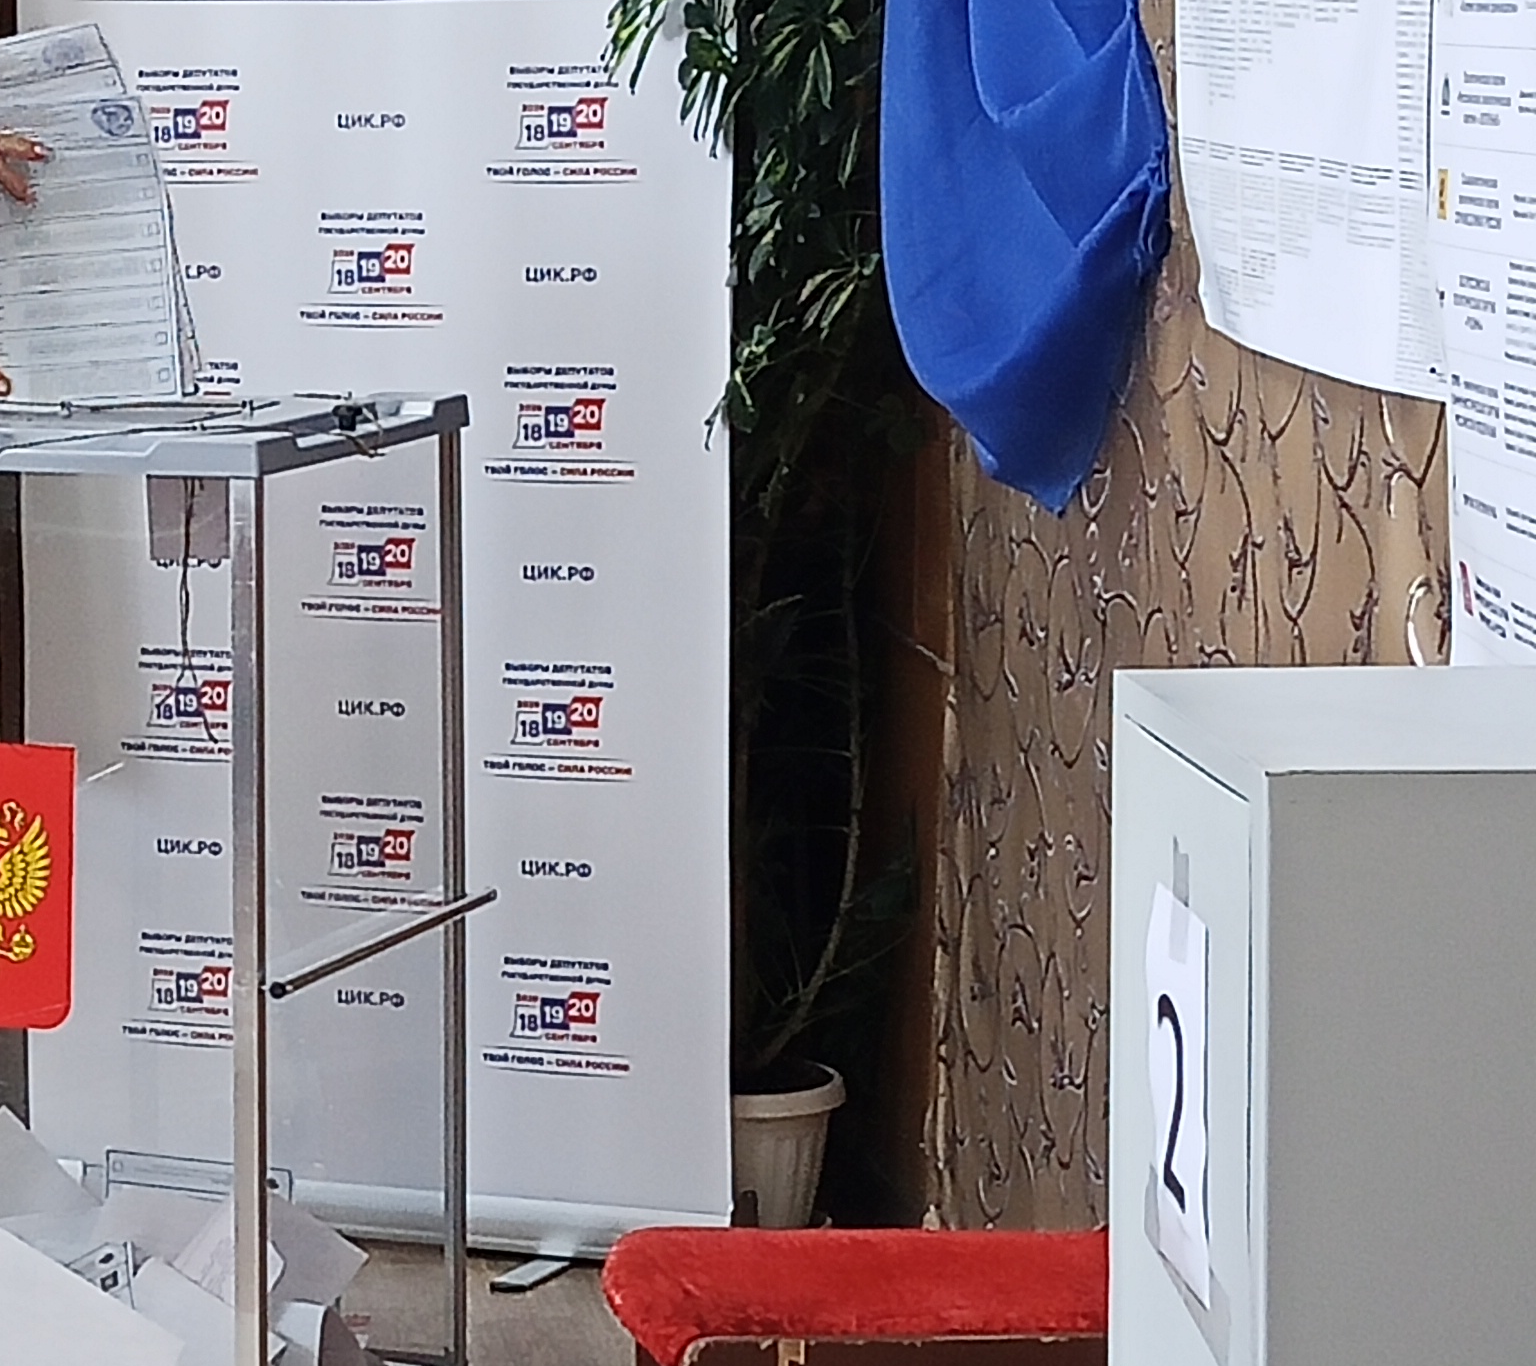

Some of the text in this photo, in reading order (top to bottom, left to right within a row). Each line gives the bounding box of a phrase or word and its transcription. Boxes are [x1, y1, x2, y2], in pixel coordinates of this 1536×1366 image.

[154, 106, 223, 142] 18 19 20
[338, 113, 405, 129] ЦИК.РФ
[525, 105, 601, 141] 18 19 20
[336, 250, 408, 286] 18 19 20
[526, 267, 597, 282] ЦИК.РФ
[523, 405, 599, 441] 18 19 20
[337, 544, 409, 578] 18 19 20
[523, 565, 594, 581] ЦИК.РФ
[178, 694, 197, 712] 19
[201, 687, 225, 704] 20
[338, 699, 405, 717] ЦИК.РФ
[520, 703, 596, 737] 18 19 20
[157, 838, 222, 856] ЦИК.РФ
[337, 836, 408, 869] 18 19 20
[521, 860, 592, 877] ЦИК.РФ
[156, 972, 225, 1004] 18 19 20
[337, 989, 405, 1007] ЦИК.РФ
[519, 999, 594, 1031] 18 19 20
[1156, 993, 1186, 1215] 2
